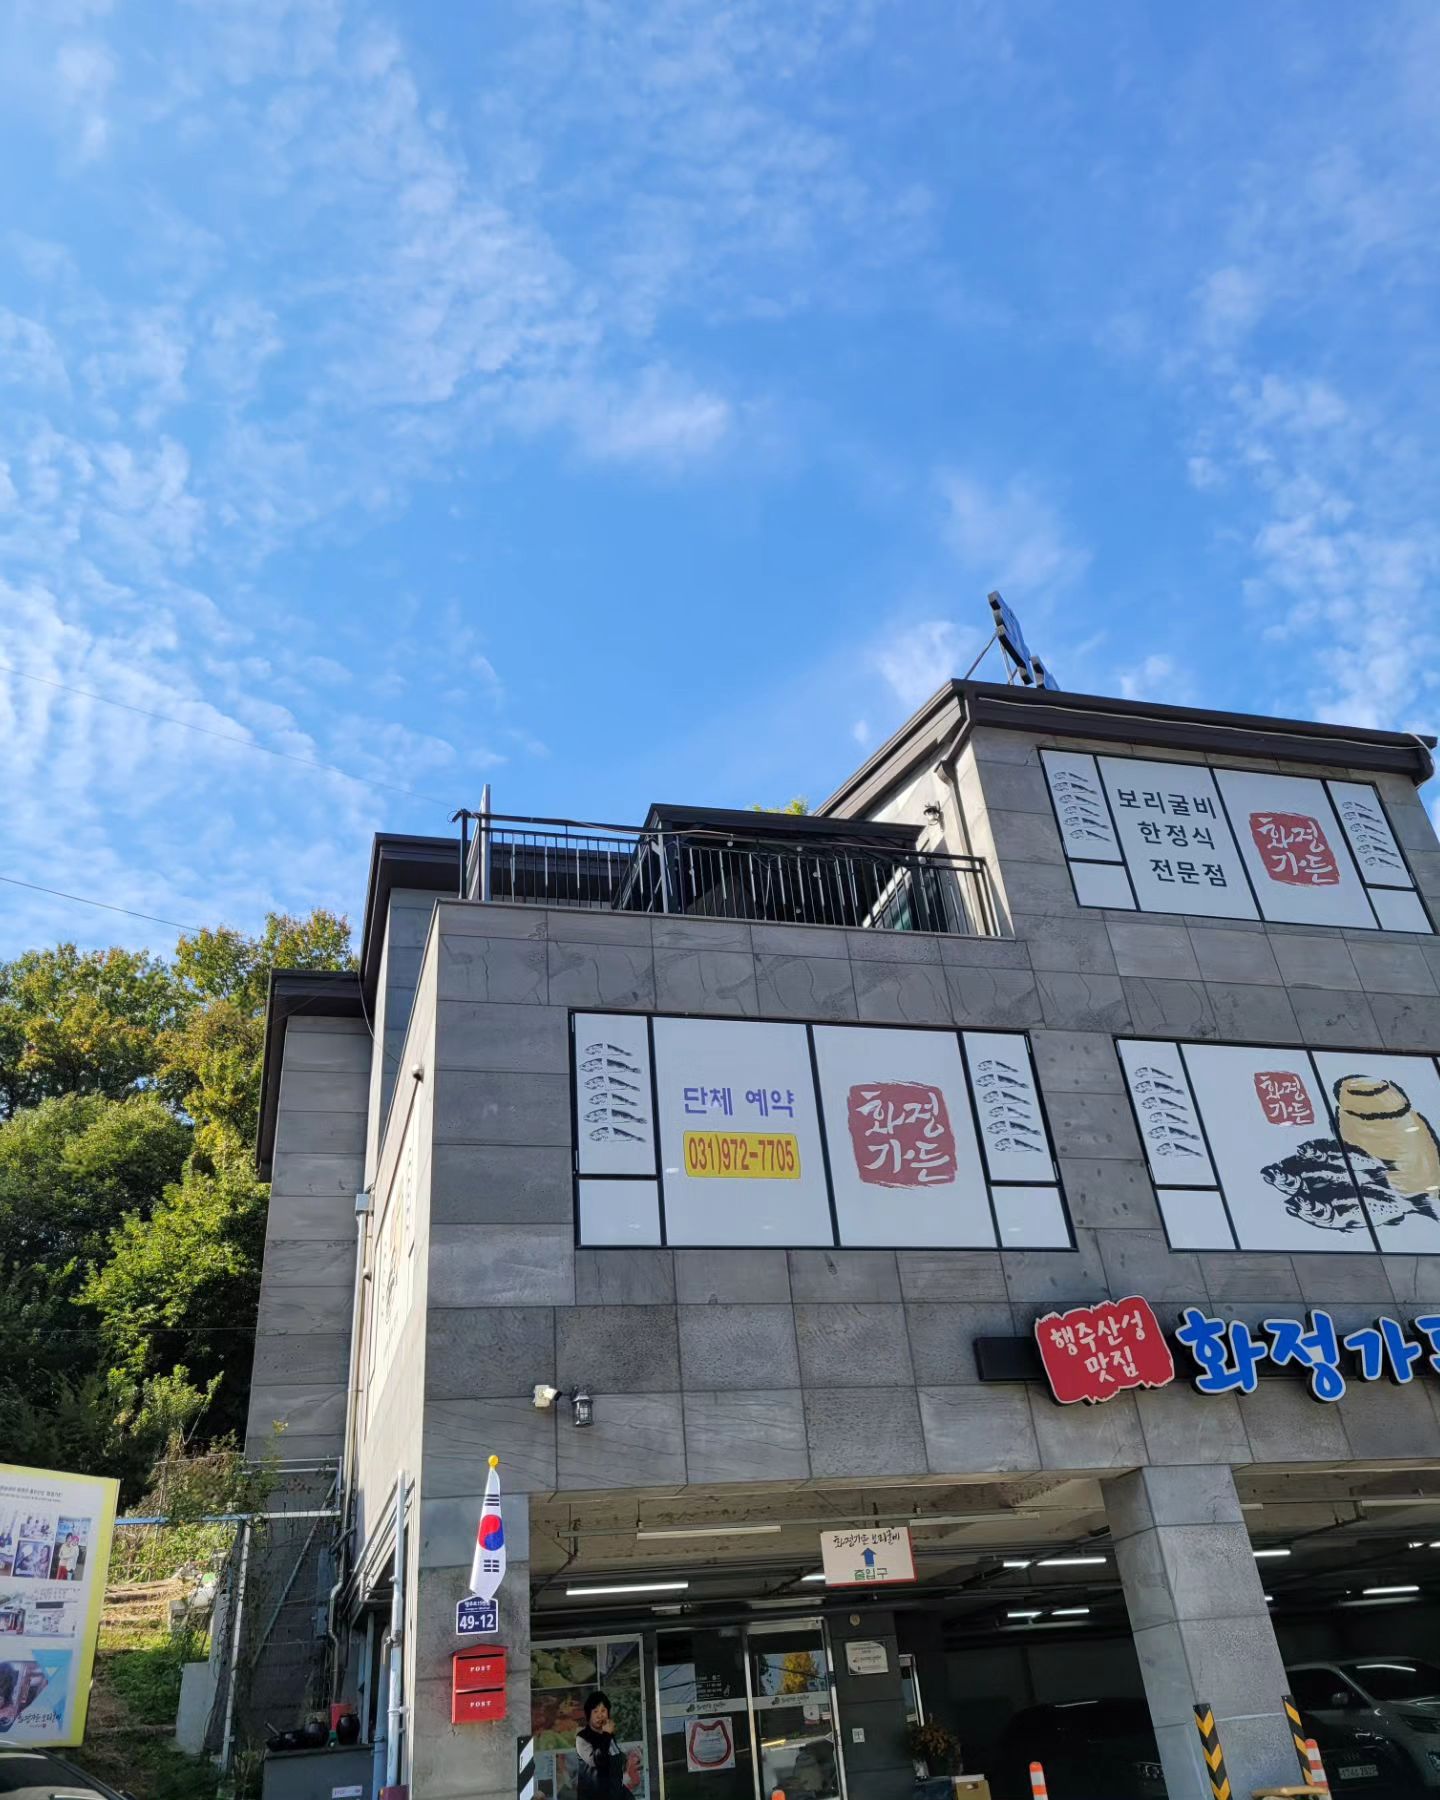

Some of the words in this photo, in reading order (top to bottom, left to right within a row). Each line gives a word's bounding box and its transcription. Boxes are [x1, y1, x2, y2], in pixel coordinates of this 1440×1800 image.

[1117, 788, 1217, 820] 보리굴비
[1137, 820, 1216, 850] 한정식
[1256, 817, 1325, 852] 화정
[1149, 857, 1228, 888] 전문점
[1270, 851, 1333, 884] 가든
[683, 1087, 734, 1117] 단체
[745, 1089, 796, 1119] 예약
[1258, 1075, 1306, 1101] 화정
[856, 1091, 945, 1139] 화정
[1268, 1100, 1313, 1124] 가든
[687, 1134, 796, 1175] 031)972-7705
[864, 1138, 951, 1183] 가든
[1049, 1310, 1146, 1356] 행주산성
[1083, 1345, 1140, 1384] 맛집
[853, 1567, 889, 1581] 출입구
[459, 1613, 495, 1630] 49-12
[470, 1664, 491, 1673] POST
[470, 1700, 491, 1708] POST
